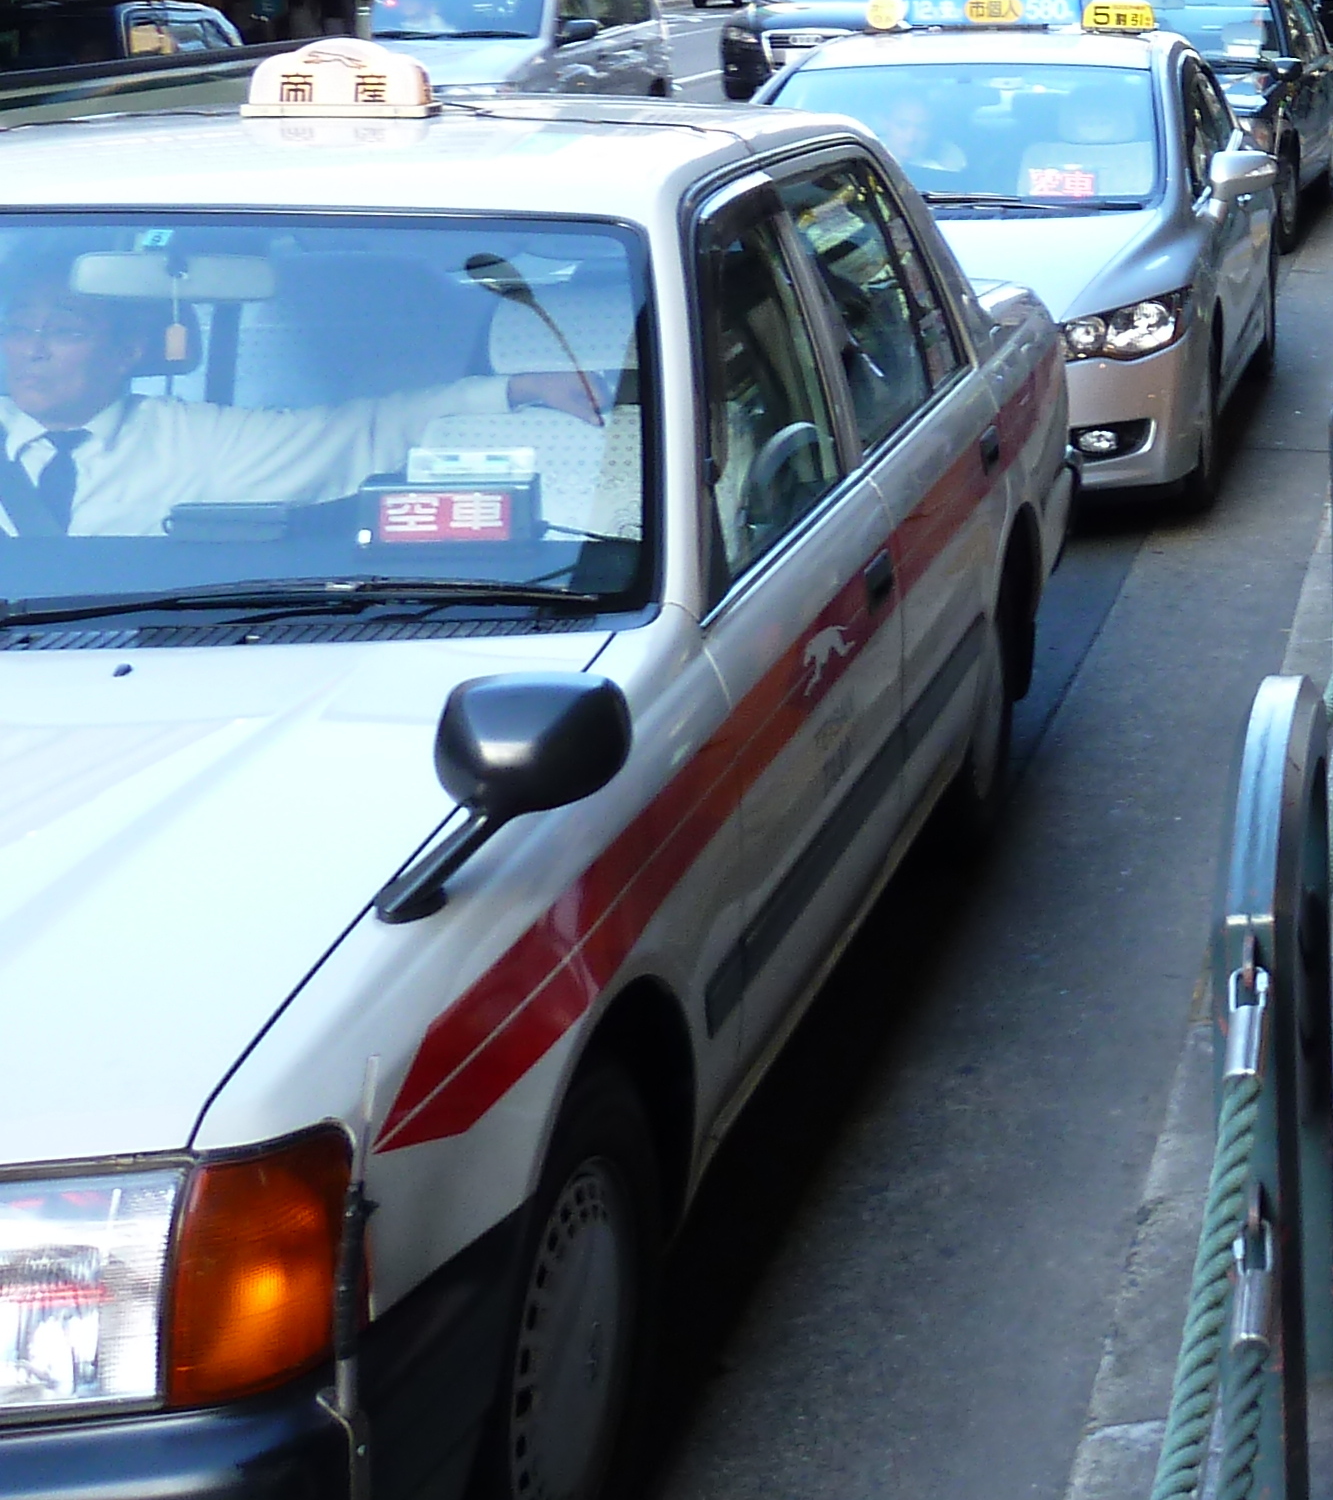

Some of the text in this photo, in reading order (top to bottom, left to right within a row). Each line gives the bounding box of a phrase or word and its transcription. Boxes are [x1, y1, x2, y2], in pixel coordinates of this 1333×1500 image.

[969, 1, 1019, 18] 市個人
[279, 73, 388, 104] 帝産
[385, 493, 504, 531] 空車
